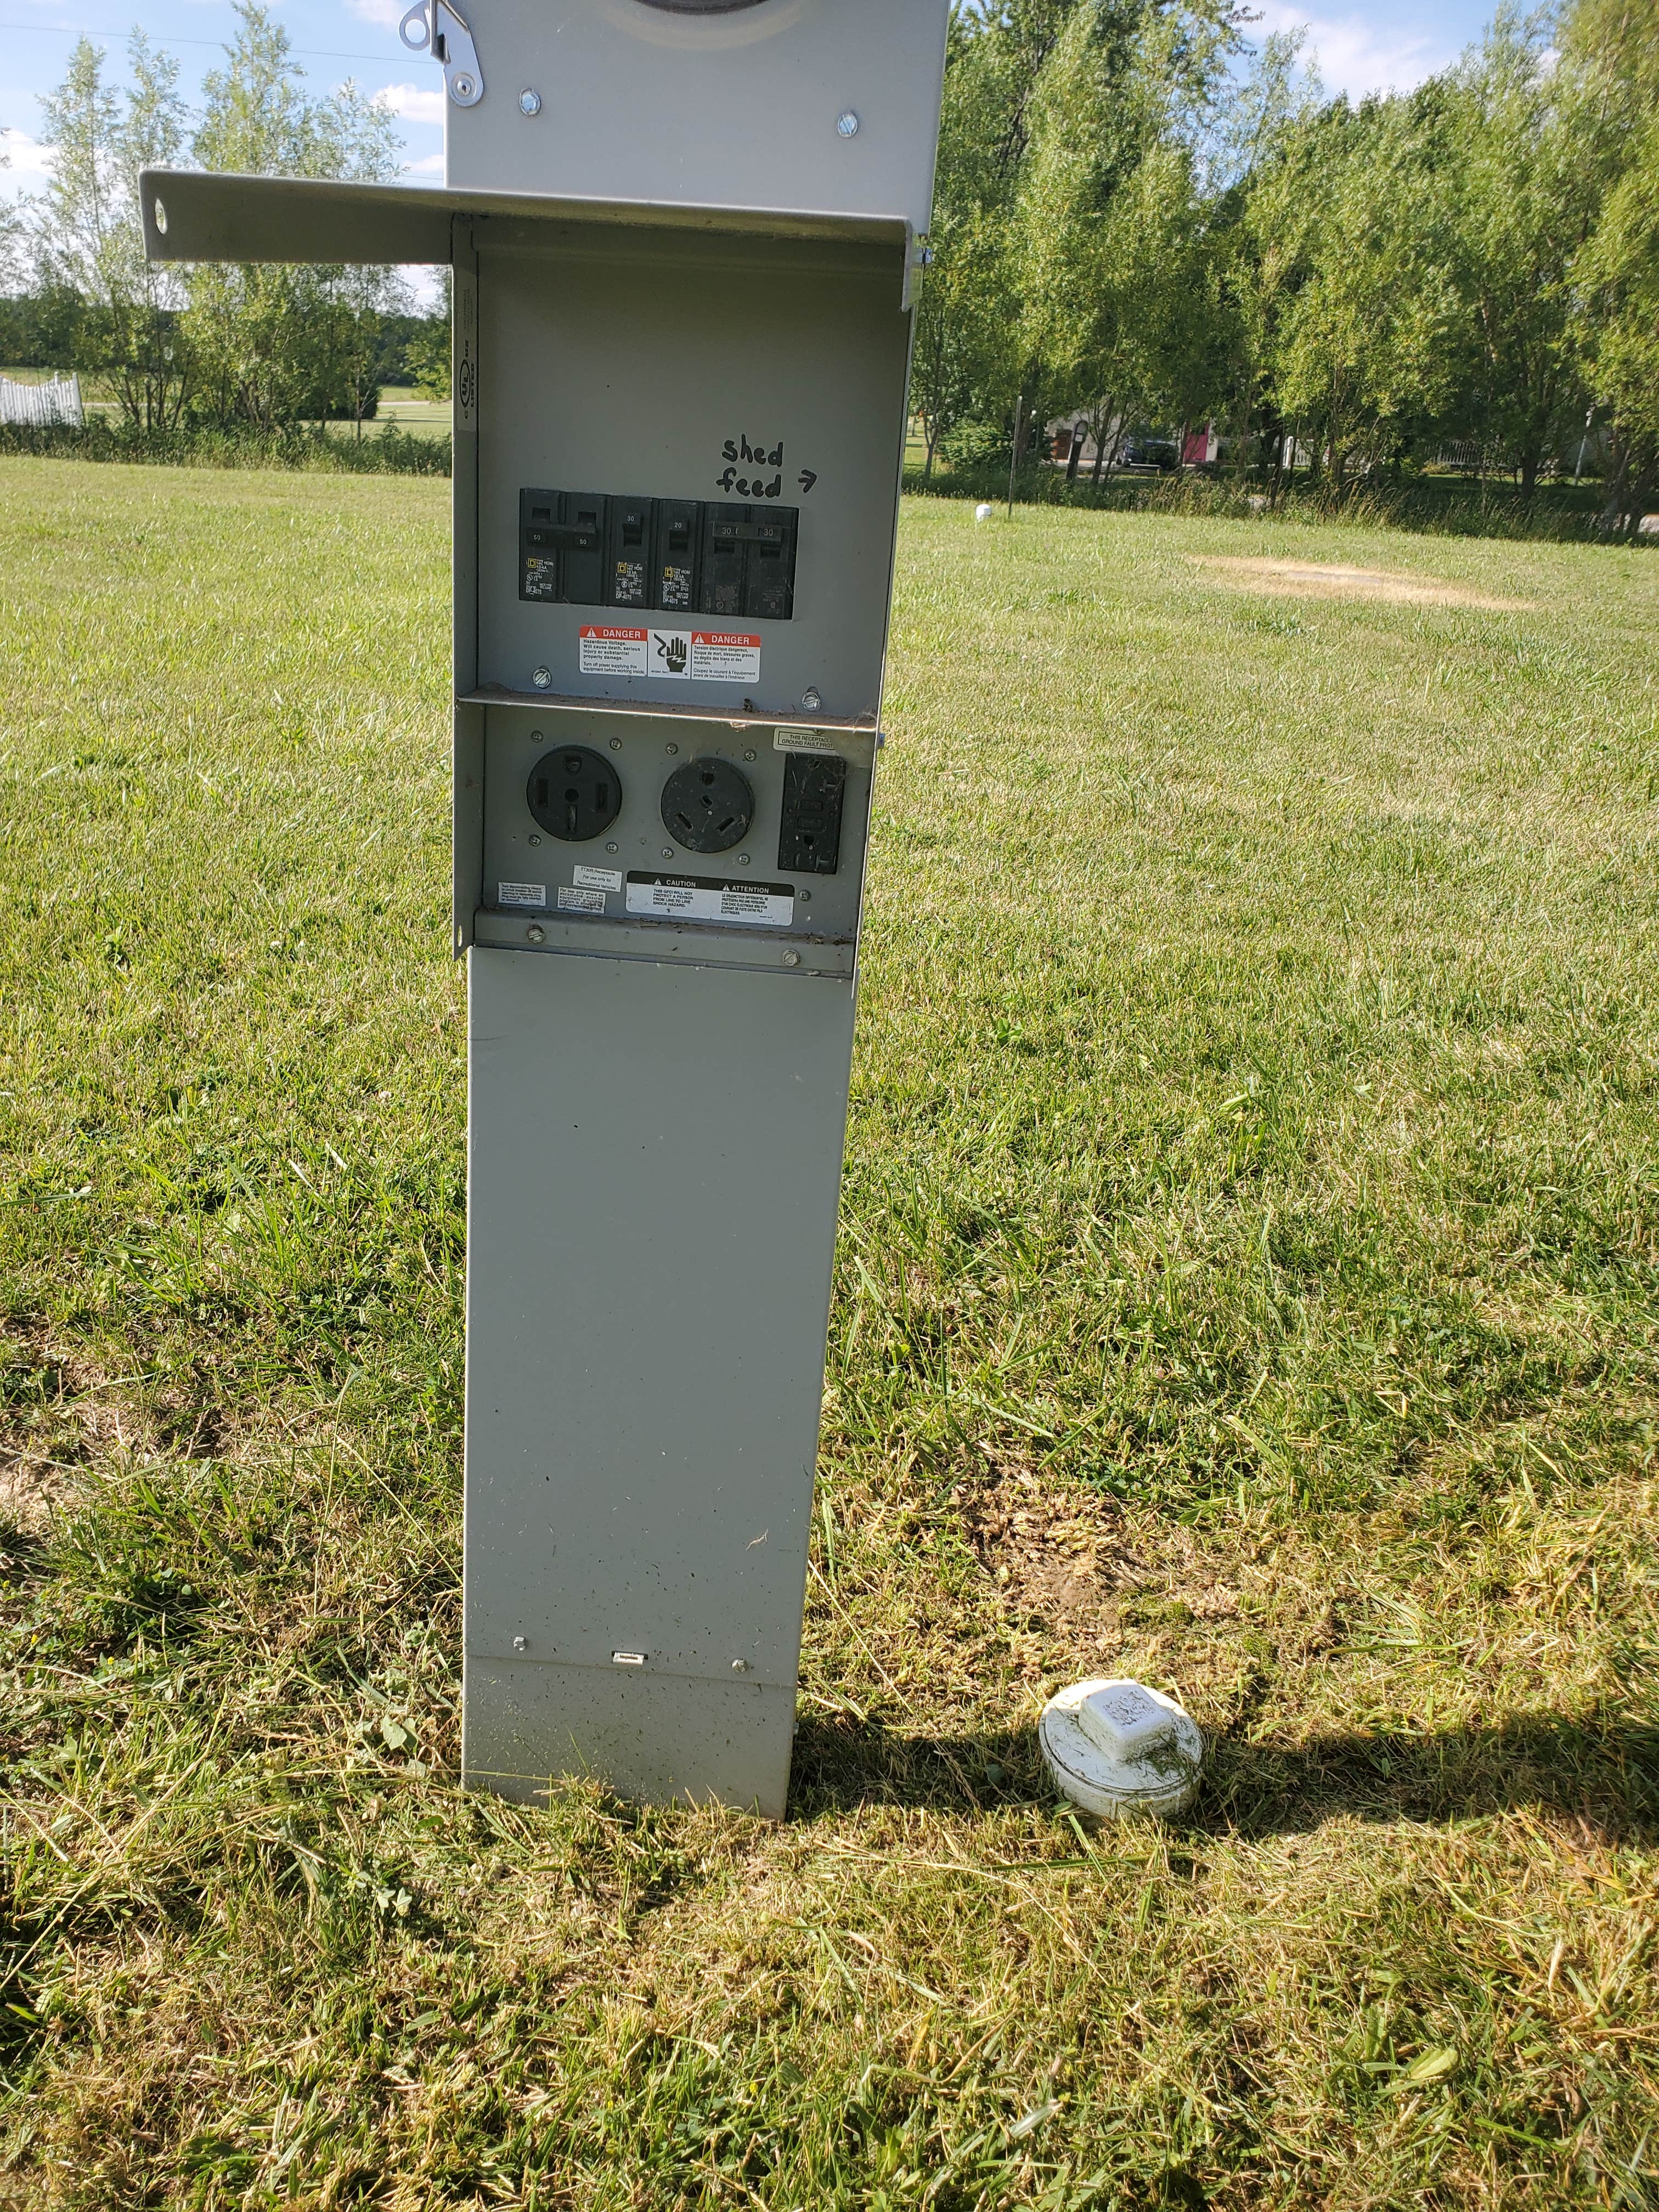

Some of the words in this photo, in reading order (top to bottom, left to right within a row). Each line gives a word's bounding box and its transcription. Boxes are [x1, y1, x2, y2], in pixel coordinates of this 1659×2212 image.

[722, 433, 783, 467] shed
[716, 467, 781, 498] feed
[603, 629, 640, 639] DANGER
[712, 635, 749, 645] DANGER
[732, 885, 769, 894] ATTENTION
